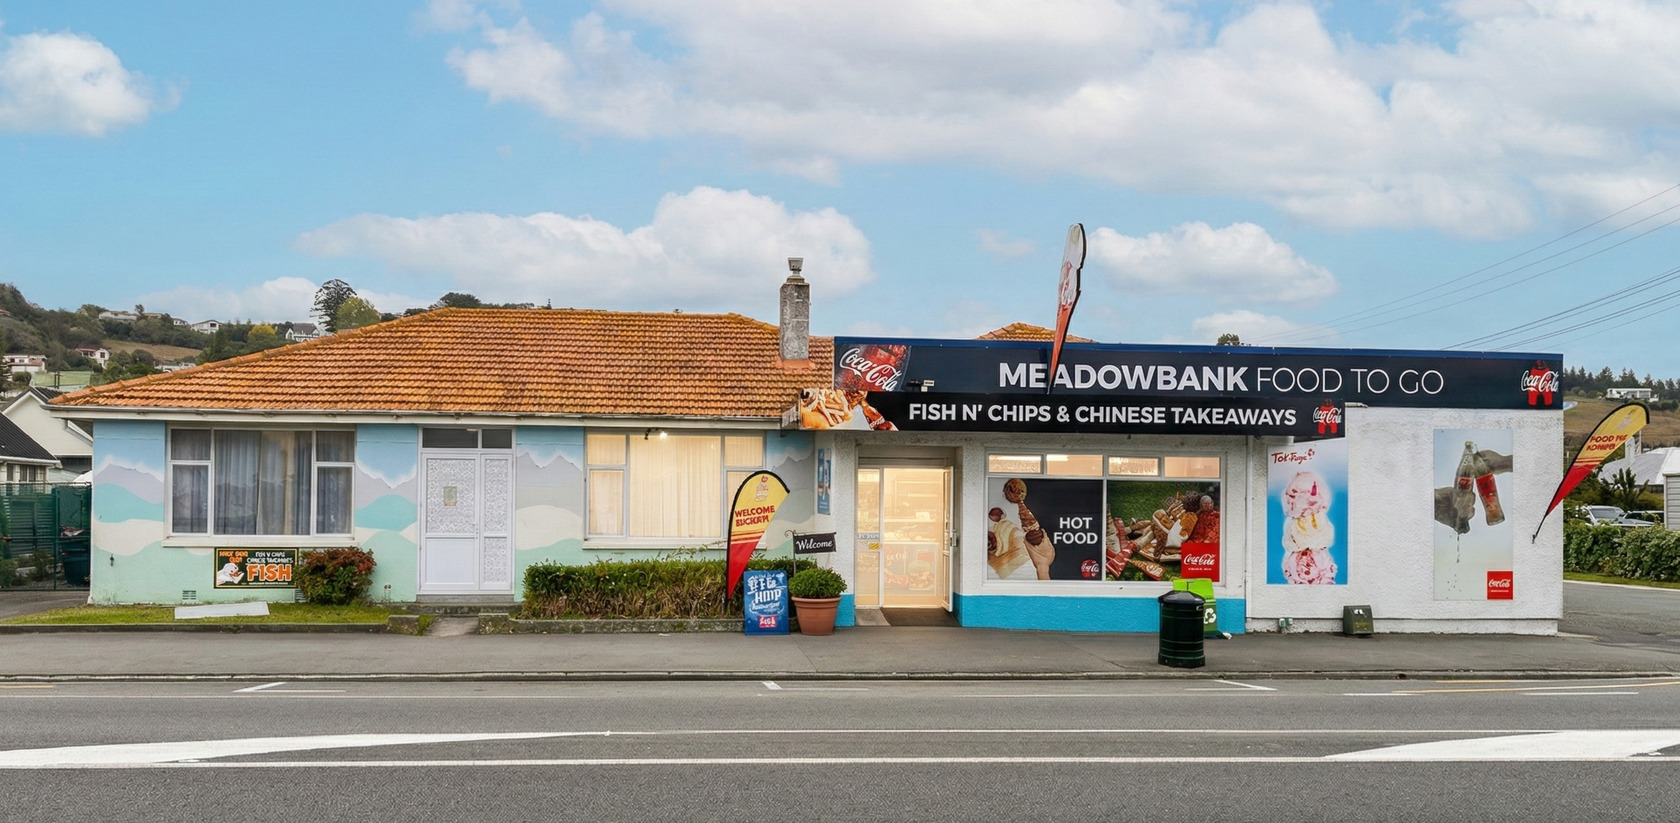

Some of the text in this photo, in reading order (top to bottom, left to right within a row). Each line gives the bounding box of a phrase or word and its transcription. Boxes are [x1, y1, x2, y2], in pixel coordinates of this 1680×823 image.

[999, 363, 1444, 395] MEADOWBANK FOOD TO GO
[908, 402, 957, 422] FISH
[961, 403, 984, 422] N'
[987, 404, 1051, 423] CHIPS
[1056, 405, 1071, 424] &
[1078, 405, 1168, 425] CHINESE
[1170, 406, 1297, 426] TAKEAWAYS
[734, 505, 776, 518] WELCOME
[1059, 517, 1093, 530] HOT
[795, 537, 834, 551] Welcome
[1053, 531, 1098, 545] FOOD
[246, 563, 292, 582] FISH
